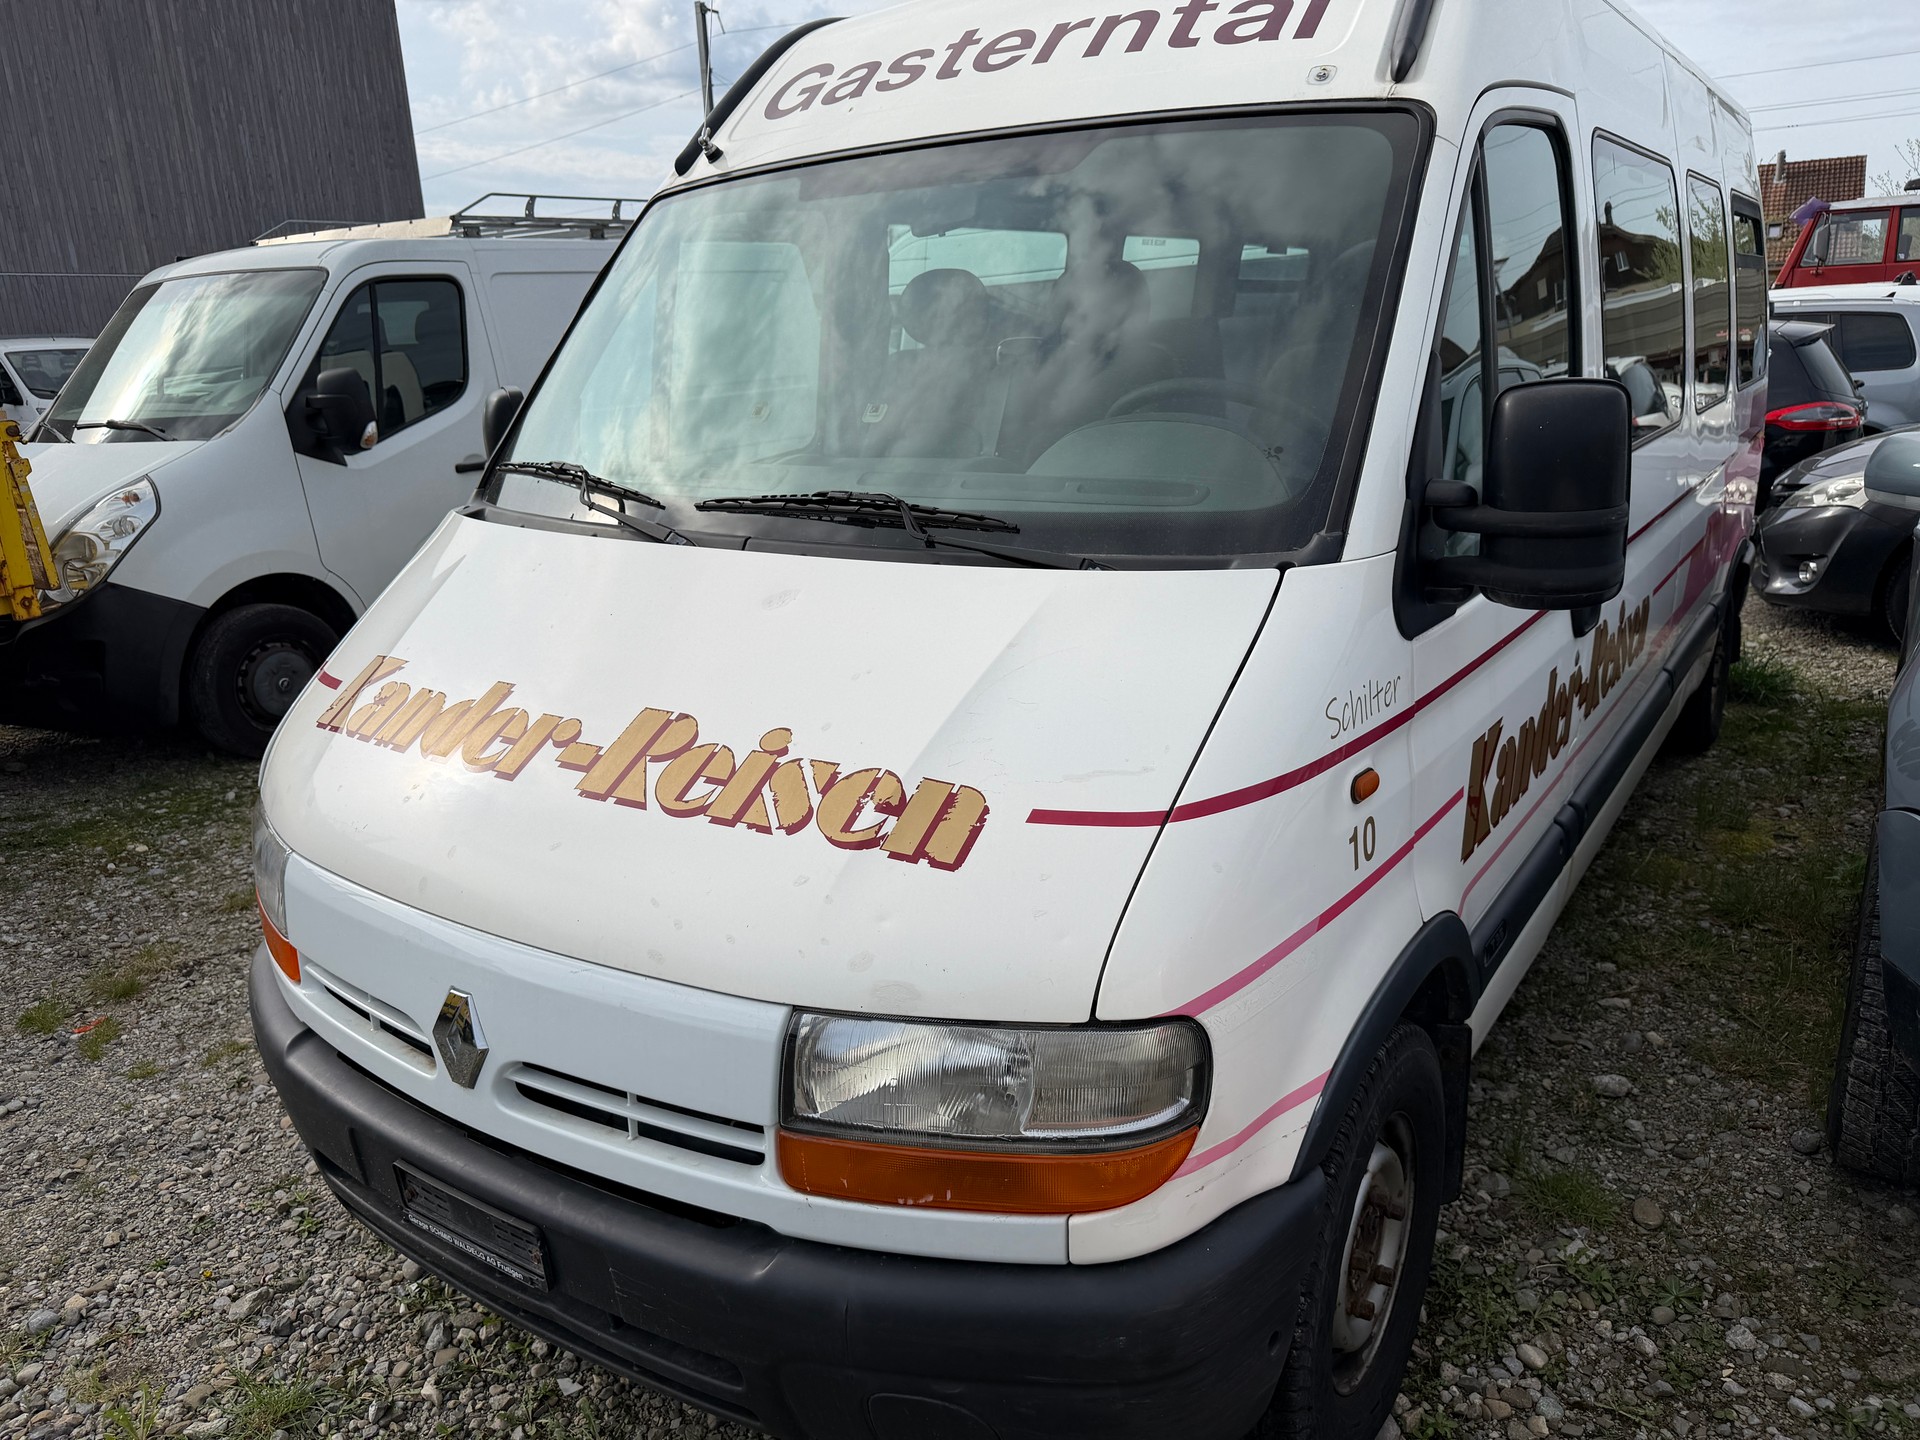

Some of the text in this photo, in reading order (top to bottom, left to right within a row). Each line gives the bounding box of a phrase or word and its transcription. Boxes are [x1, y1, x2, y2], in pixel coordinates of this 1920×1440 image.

[764, 0, 1331, 120] Gasterntal
[1325, 675, 1402, 740] Schilter
[315, 654, 991, 873] Kander-Reisen
[1348, 816, 1377, 871] 10
[408, 1214, 429, 1230] Garage
